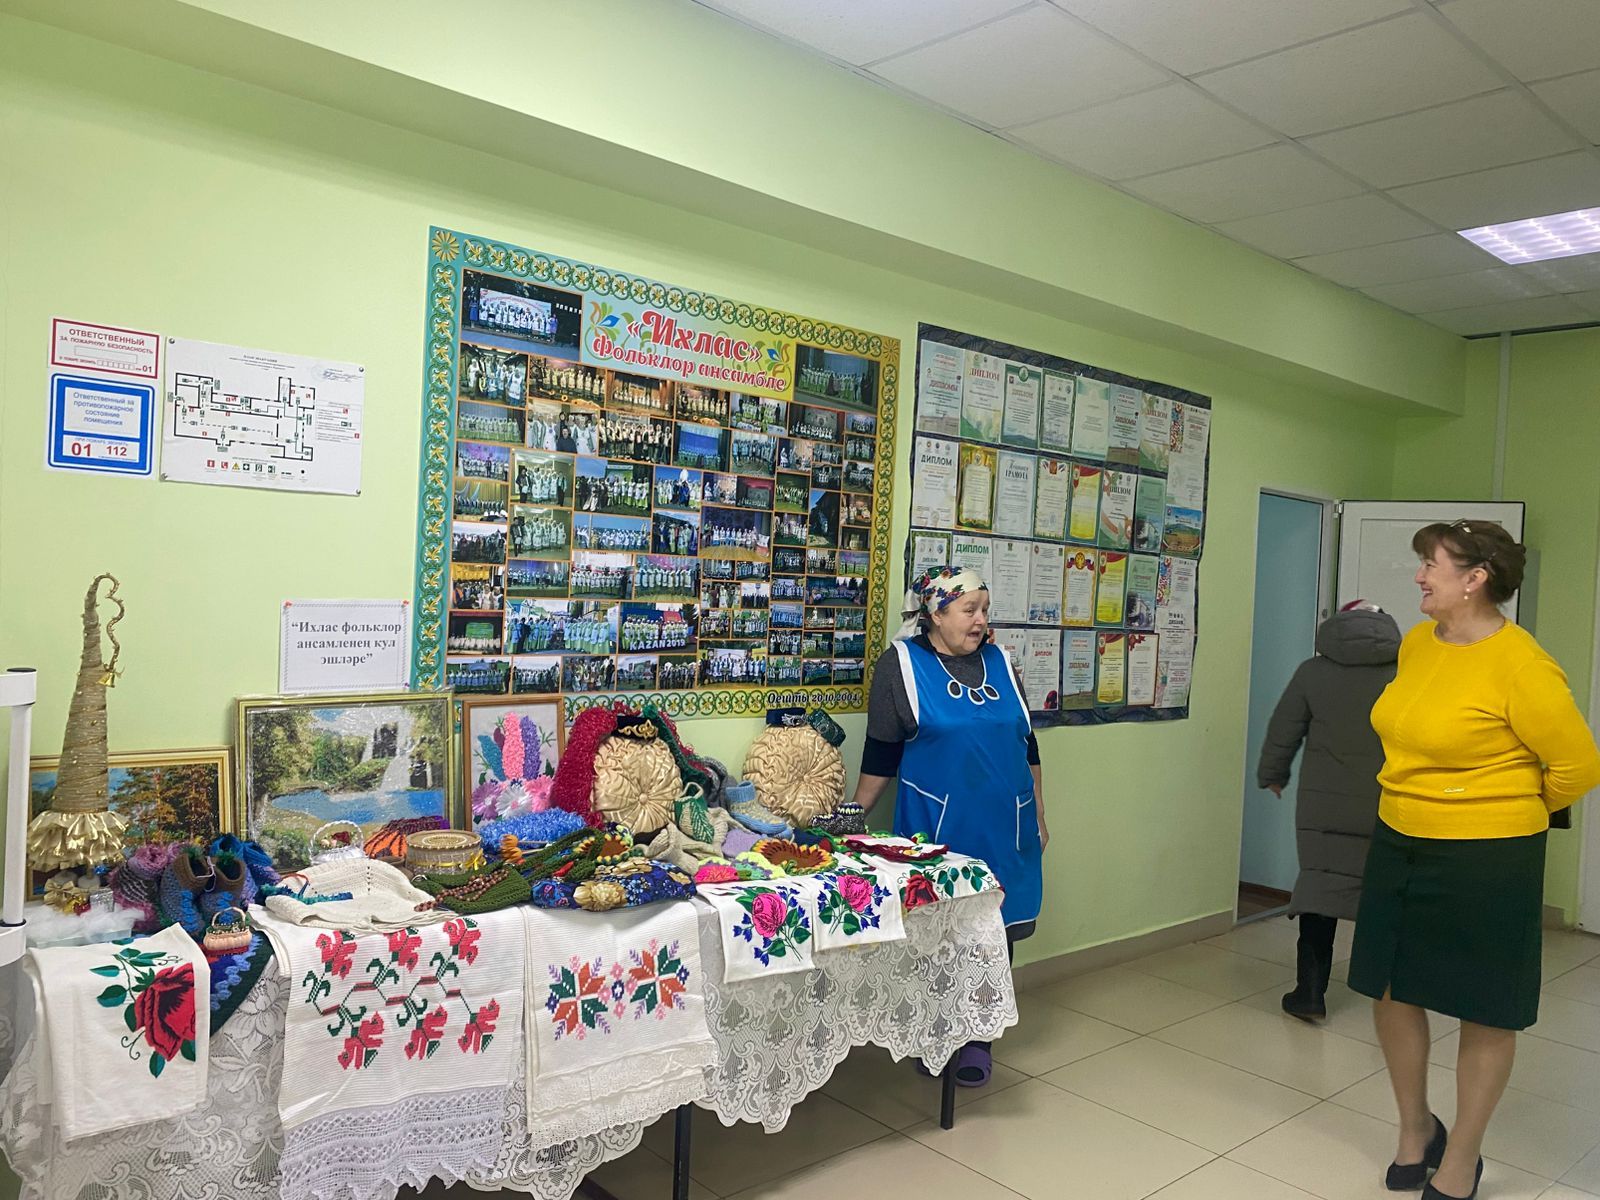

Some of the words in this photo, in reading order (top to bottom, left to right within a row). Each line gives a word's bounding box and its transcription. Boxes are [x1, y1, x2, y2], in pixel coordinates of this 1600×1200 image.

[69, 328, 145, 346] ОТВЕТСТВЕННЫЙ
[627, 310, 762, 363] «Ихлас»
[70, 338, 105, 347] ПОЖАРНУЮ
[107, 343, 154, 354] БЕЗОПАСНОСТЬ
[142, 365, 152, 373] 01
[698, 362, 786, 392] ансамбле
[73, 392, 126, 404] Ответственный
[73, 401, 134, 413] противопожарное
[85, 409, 120, 419] состояние
[83, 417, 123, 426] помещения
[71, 442, 91, 457] 01
[106, 445, 127, 457] 112
[920, 454, 953, 467] ДИПЛОМ
[955, 544, 989, 555] ДИПЛОМ
[291, 621, 338, 633] “Ихлас
[341, 621, 402, 635] фольклор
[297, 639, 371, 650] ансамленең
[374, 639, 396, 651] кул
[320, 653, 373, 667] эшләре”
